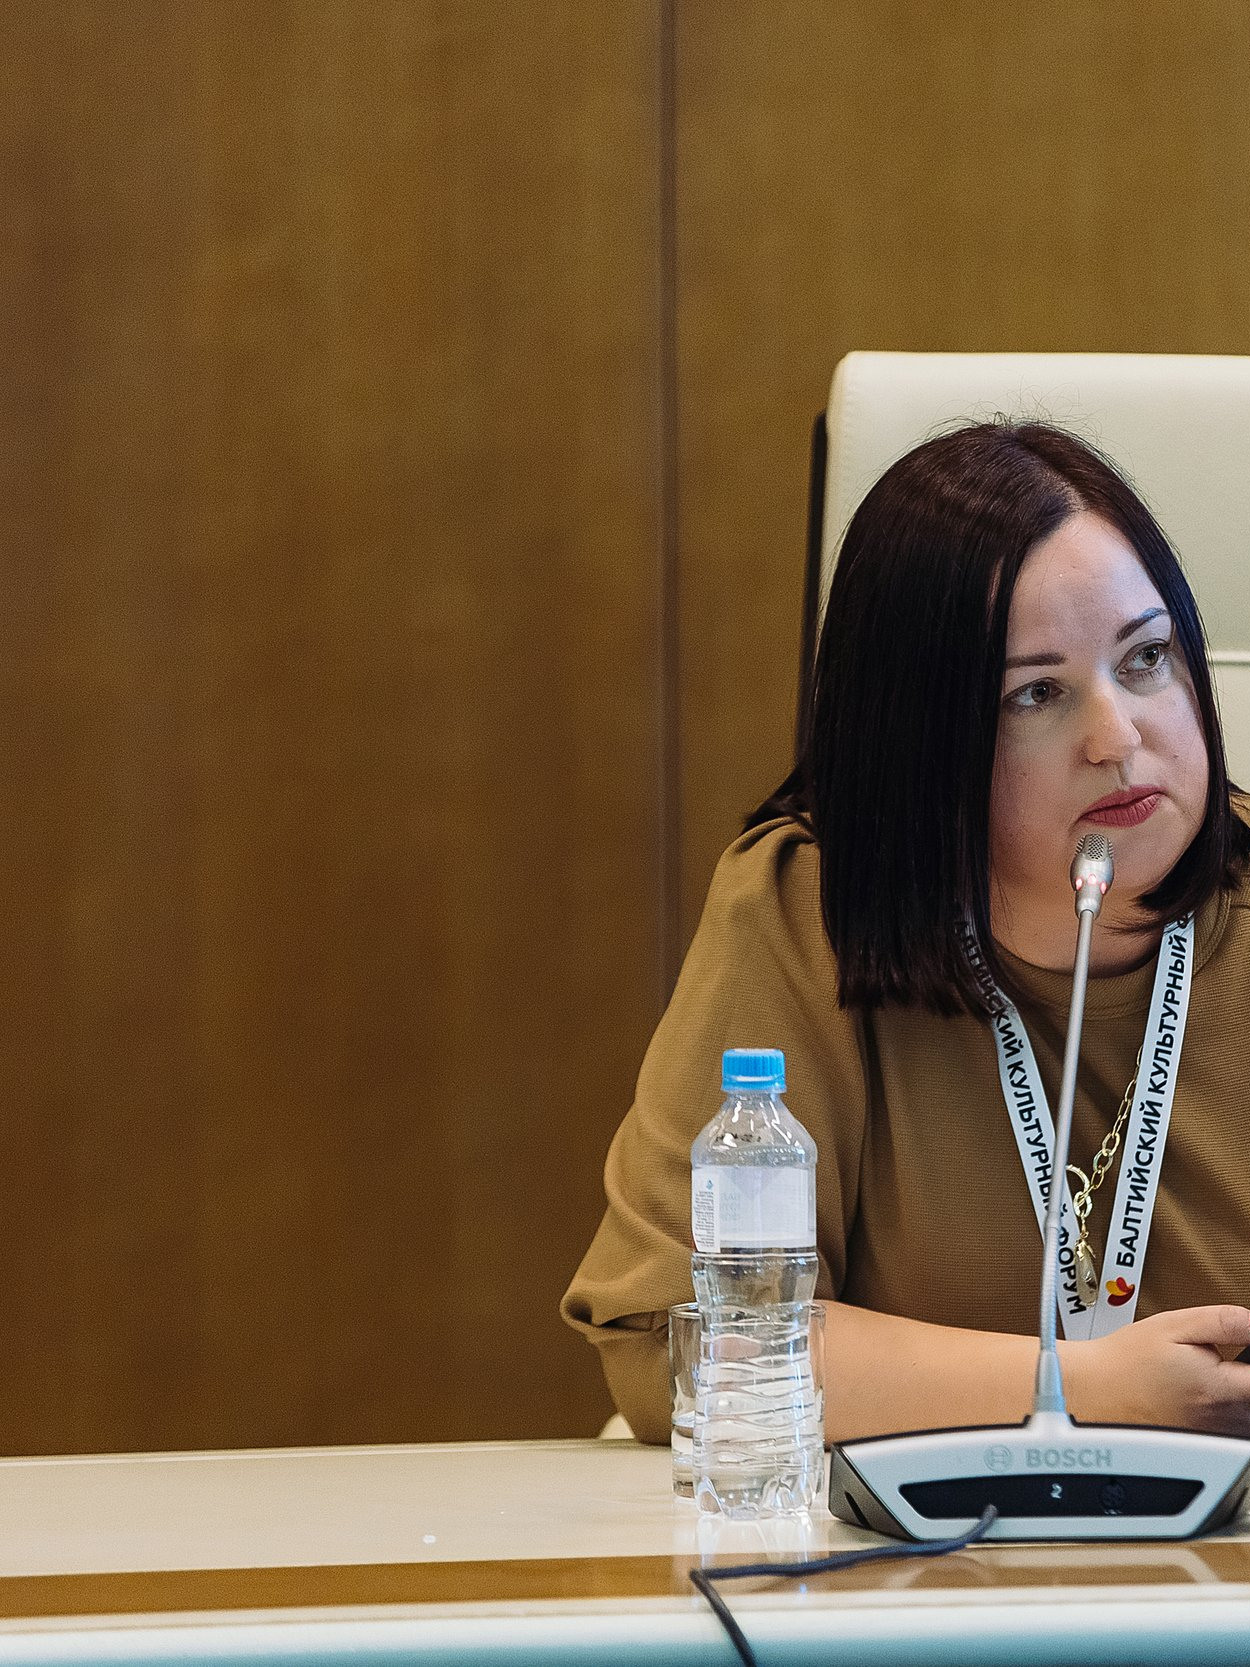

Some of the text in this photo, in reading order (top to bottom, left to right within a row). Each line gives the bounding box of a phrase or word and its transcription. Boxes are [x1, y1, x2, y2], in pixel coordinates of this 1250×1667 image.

[955, 921, 1024, 1058] ЛТИЙСКИЙ
[1007, 1060, 1068, 1217] КУЛЬТУРНЫ
[1116, 934, 1187, 1267] БАЛТИЙСКИЙ КУЛЬТУРНЫЙ
[1025, 1448, 1112, 1468] BOSCH
[1050, 1483, 1062, 1498] 2
